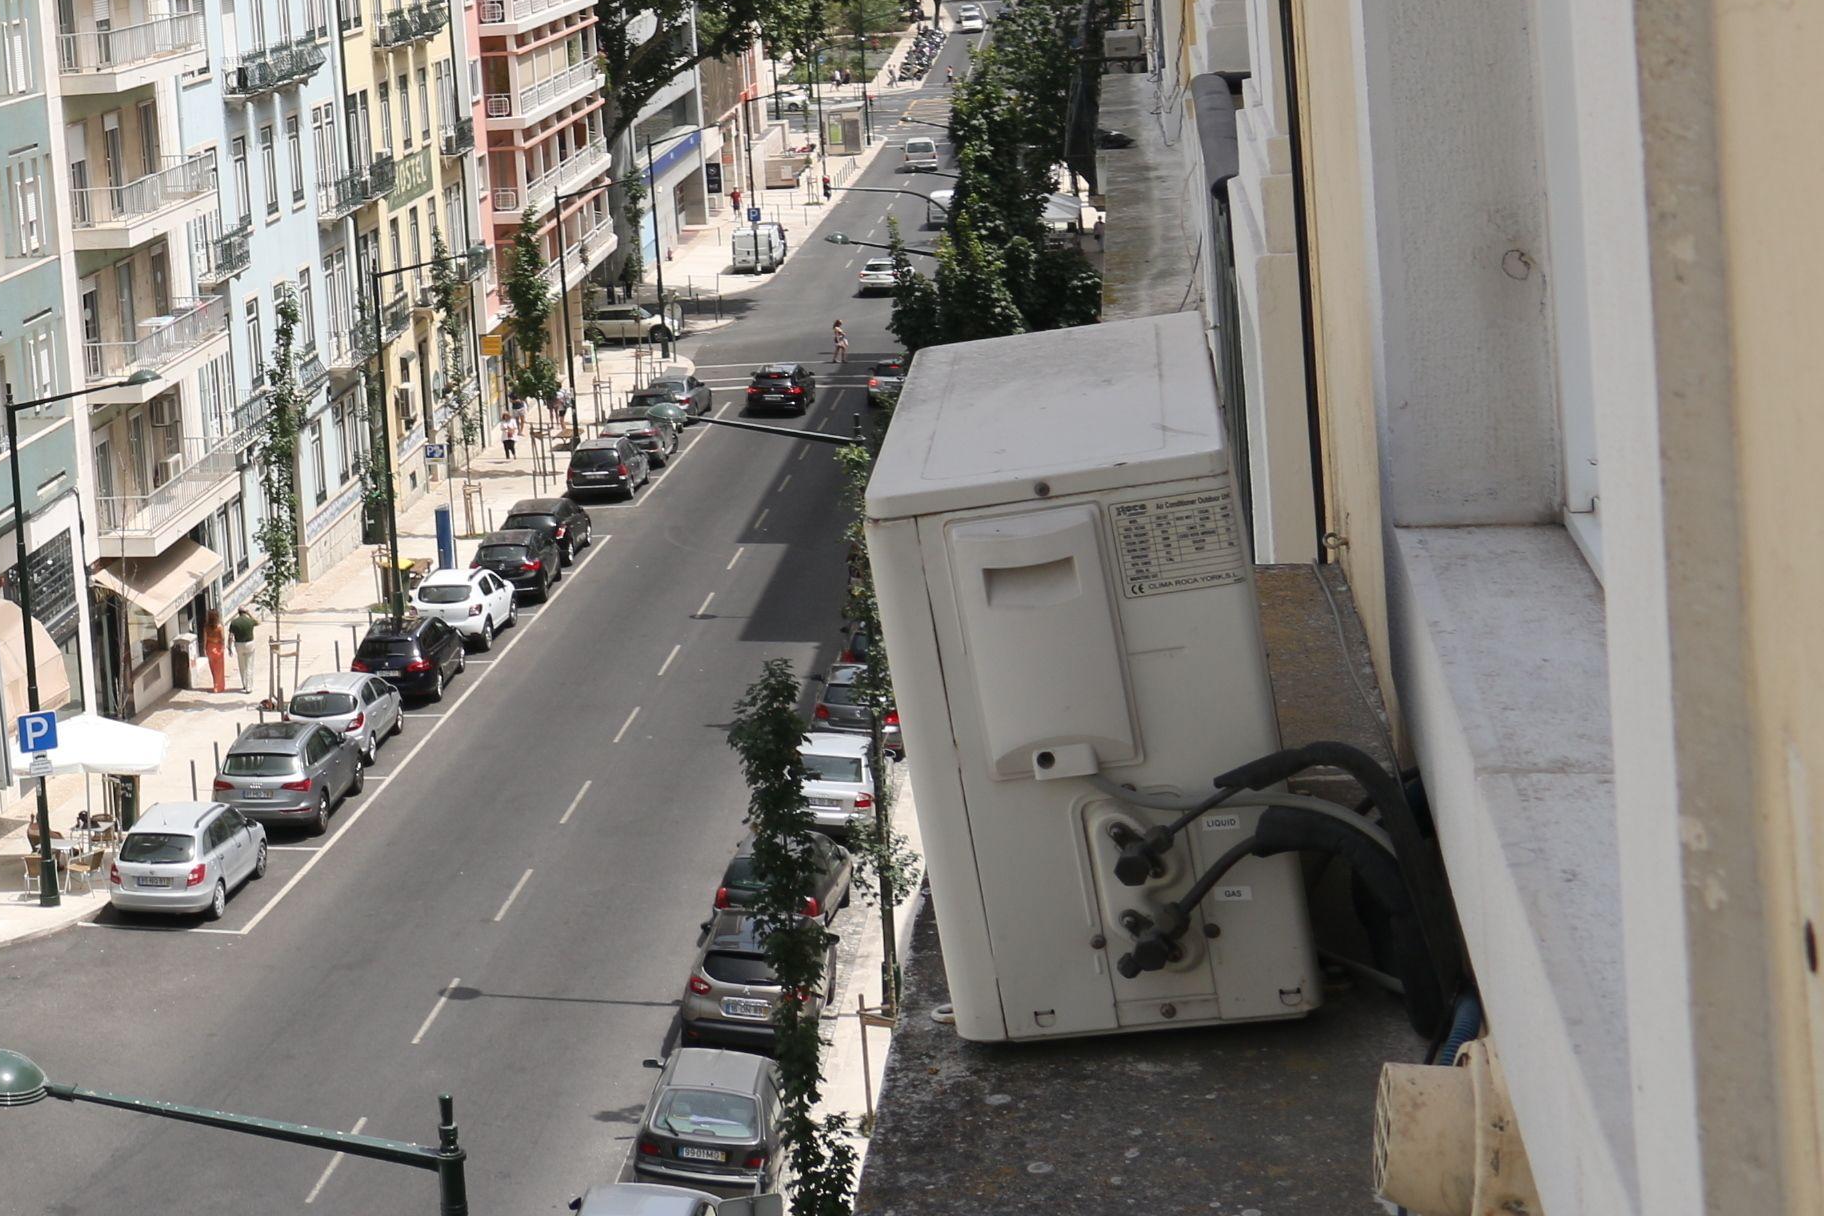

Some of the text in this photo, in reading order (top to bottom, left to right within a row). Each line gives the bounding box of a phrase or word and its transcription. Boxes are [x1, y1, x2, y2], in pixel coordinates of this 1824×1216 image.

[750, 209, 758, 220] P
[1165, 498, 1197, 509] Conditioner
[1198, 495, 1220, 505] Outdoor
[1148, 580, 1173, 590] CLIMA
[1175, 577, 1199, 586] ROCA
[25, 717, 49, 749] P
[1206, 818, 1236, 828] LIQUID
[1224, 889, 1242, 898] GAS
